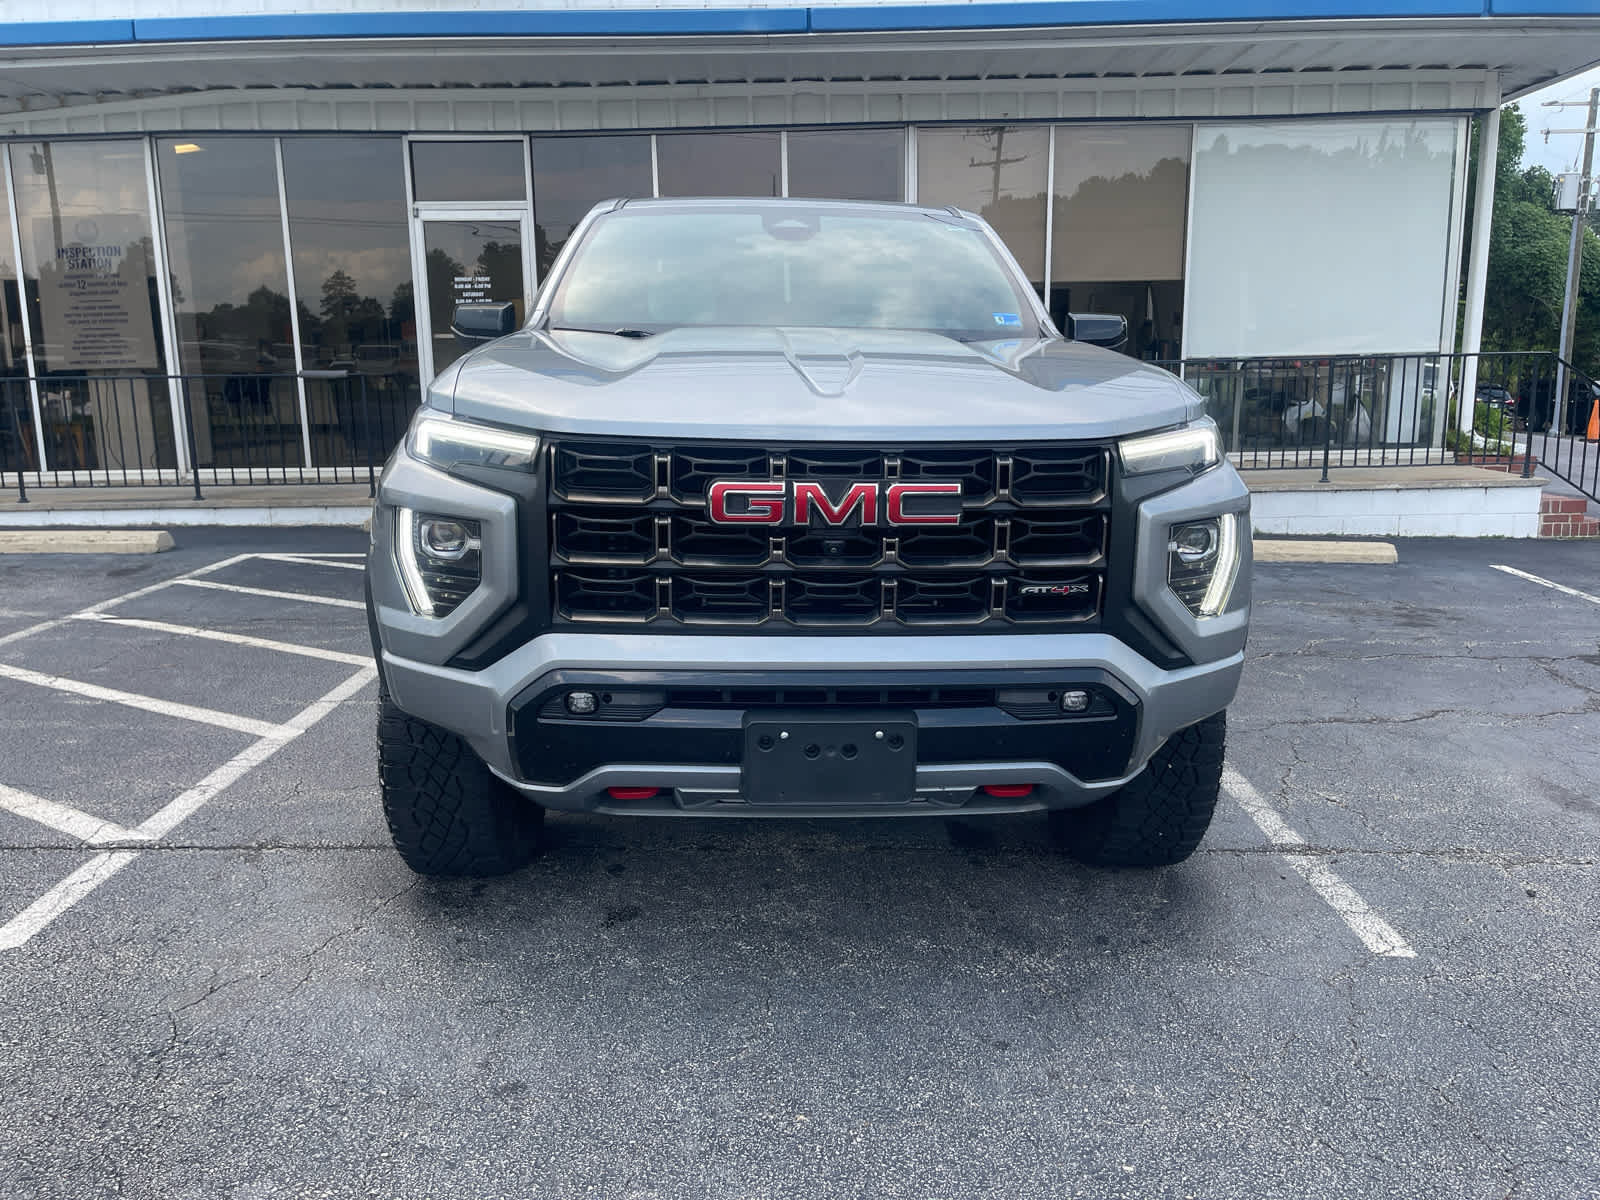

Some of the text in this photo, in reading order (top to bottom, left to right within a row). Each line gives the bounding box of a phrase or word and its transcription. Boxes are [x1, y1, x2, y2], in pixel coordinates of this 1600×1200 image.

[57, 245, 121, 260] INSPECTION
[68, 258, 112, 270] STATION
[77, 279, 87, 290] 12
[709, 481, 961, 526] GMC
[1021, 584, 1089, 596] AT4X
